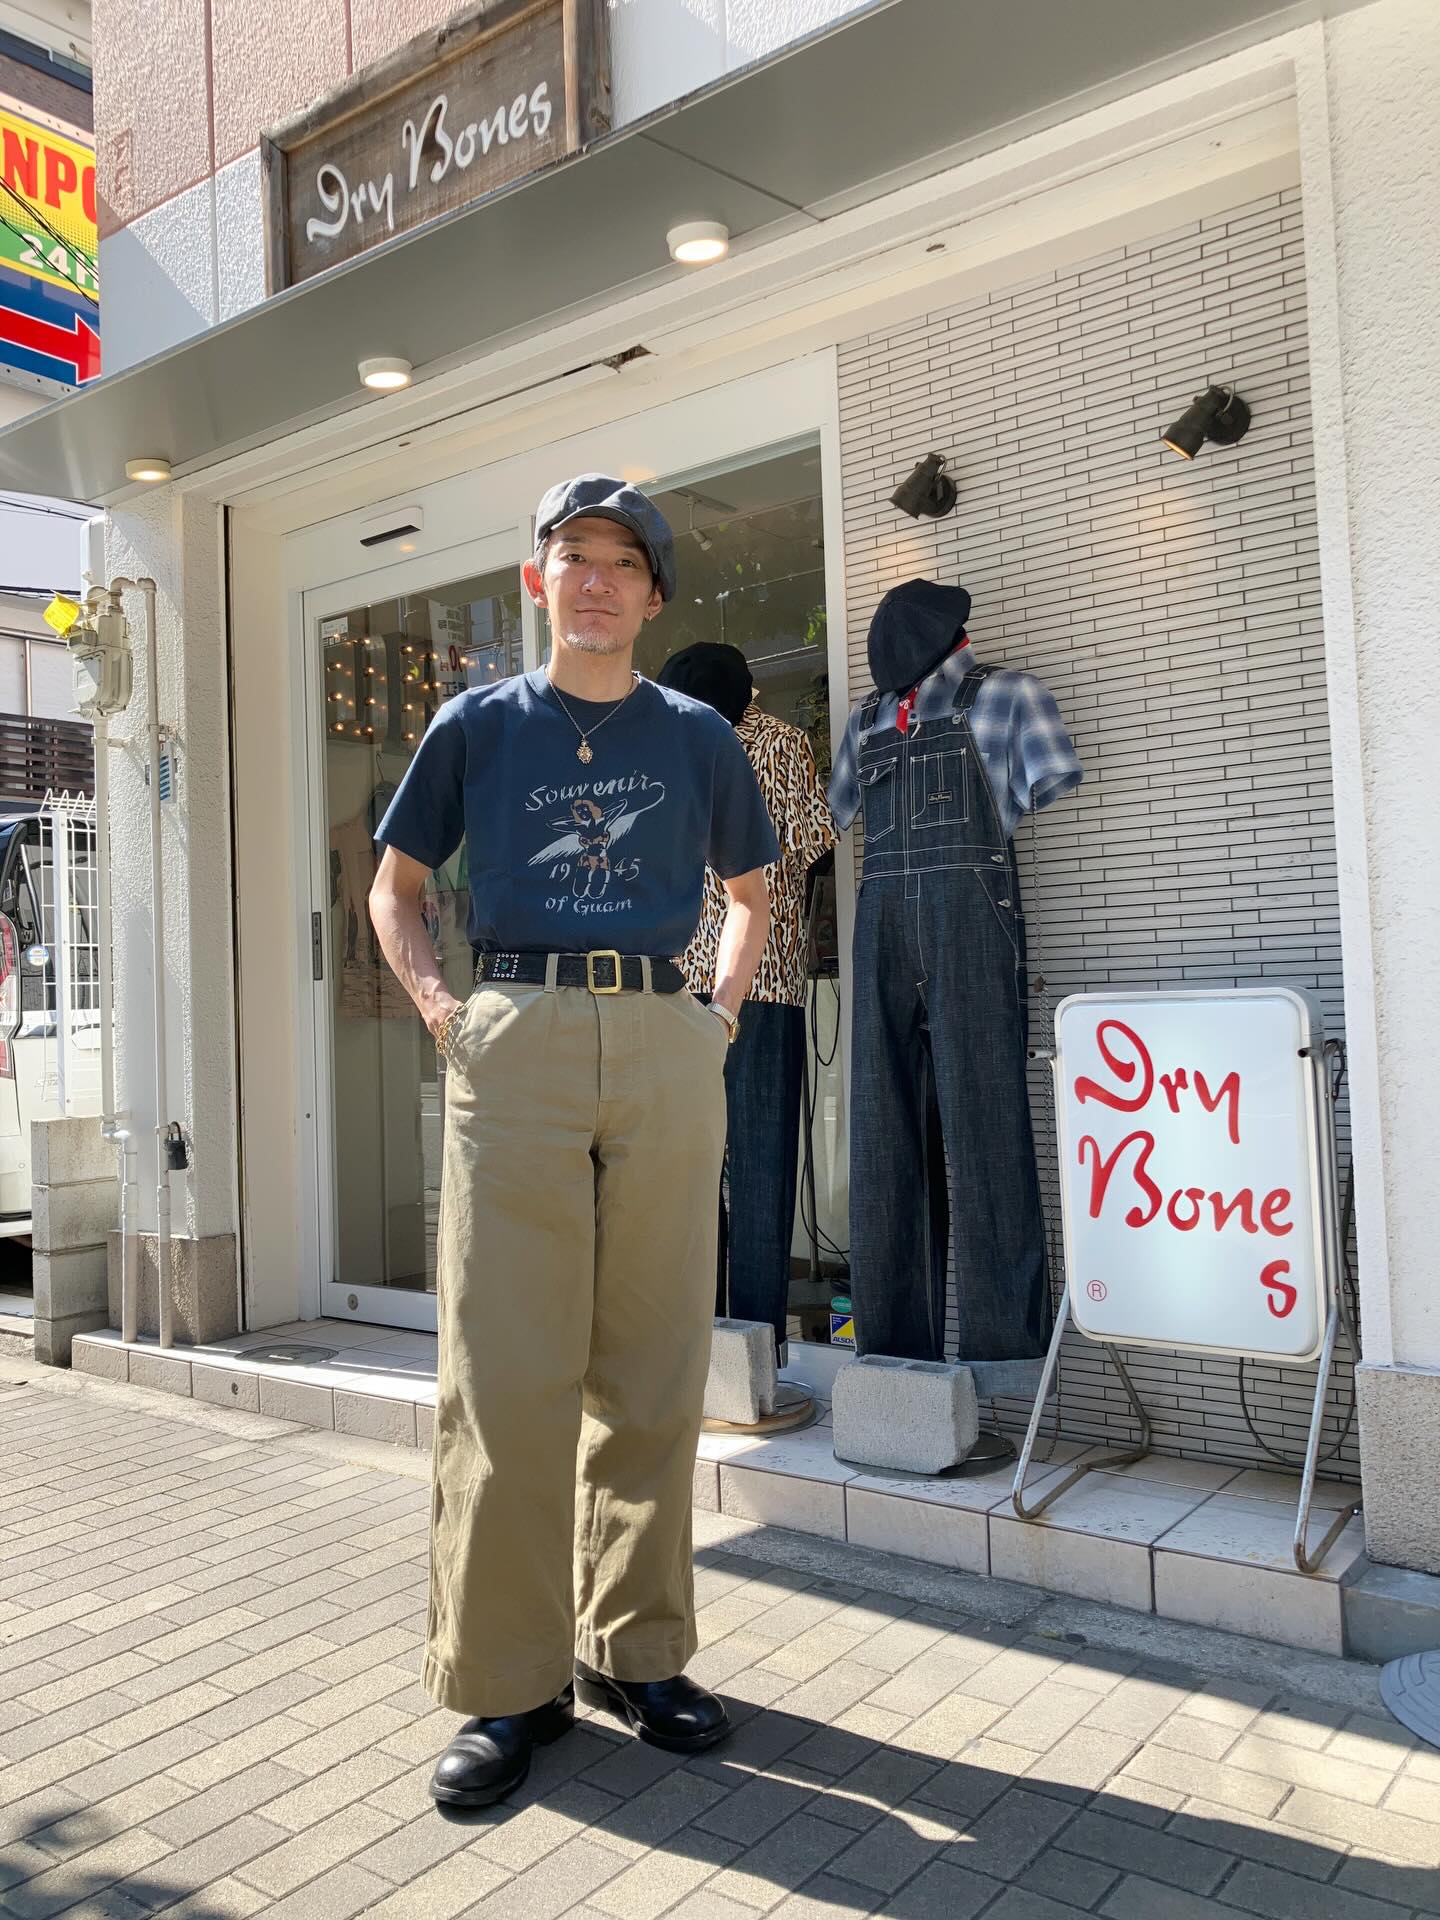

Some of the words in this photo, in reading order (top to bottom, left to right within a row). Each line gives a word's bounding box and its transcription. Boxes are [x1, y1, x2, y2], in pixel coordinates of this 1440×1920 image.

[401, 81, 552, 193] Bones
[525, 770, 665, 812] Souvenir
[545, 895, 569, 914] of
[573, 898, 633, 916] Guam
[1074, 1019, 1241, 1145] Dry
